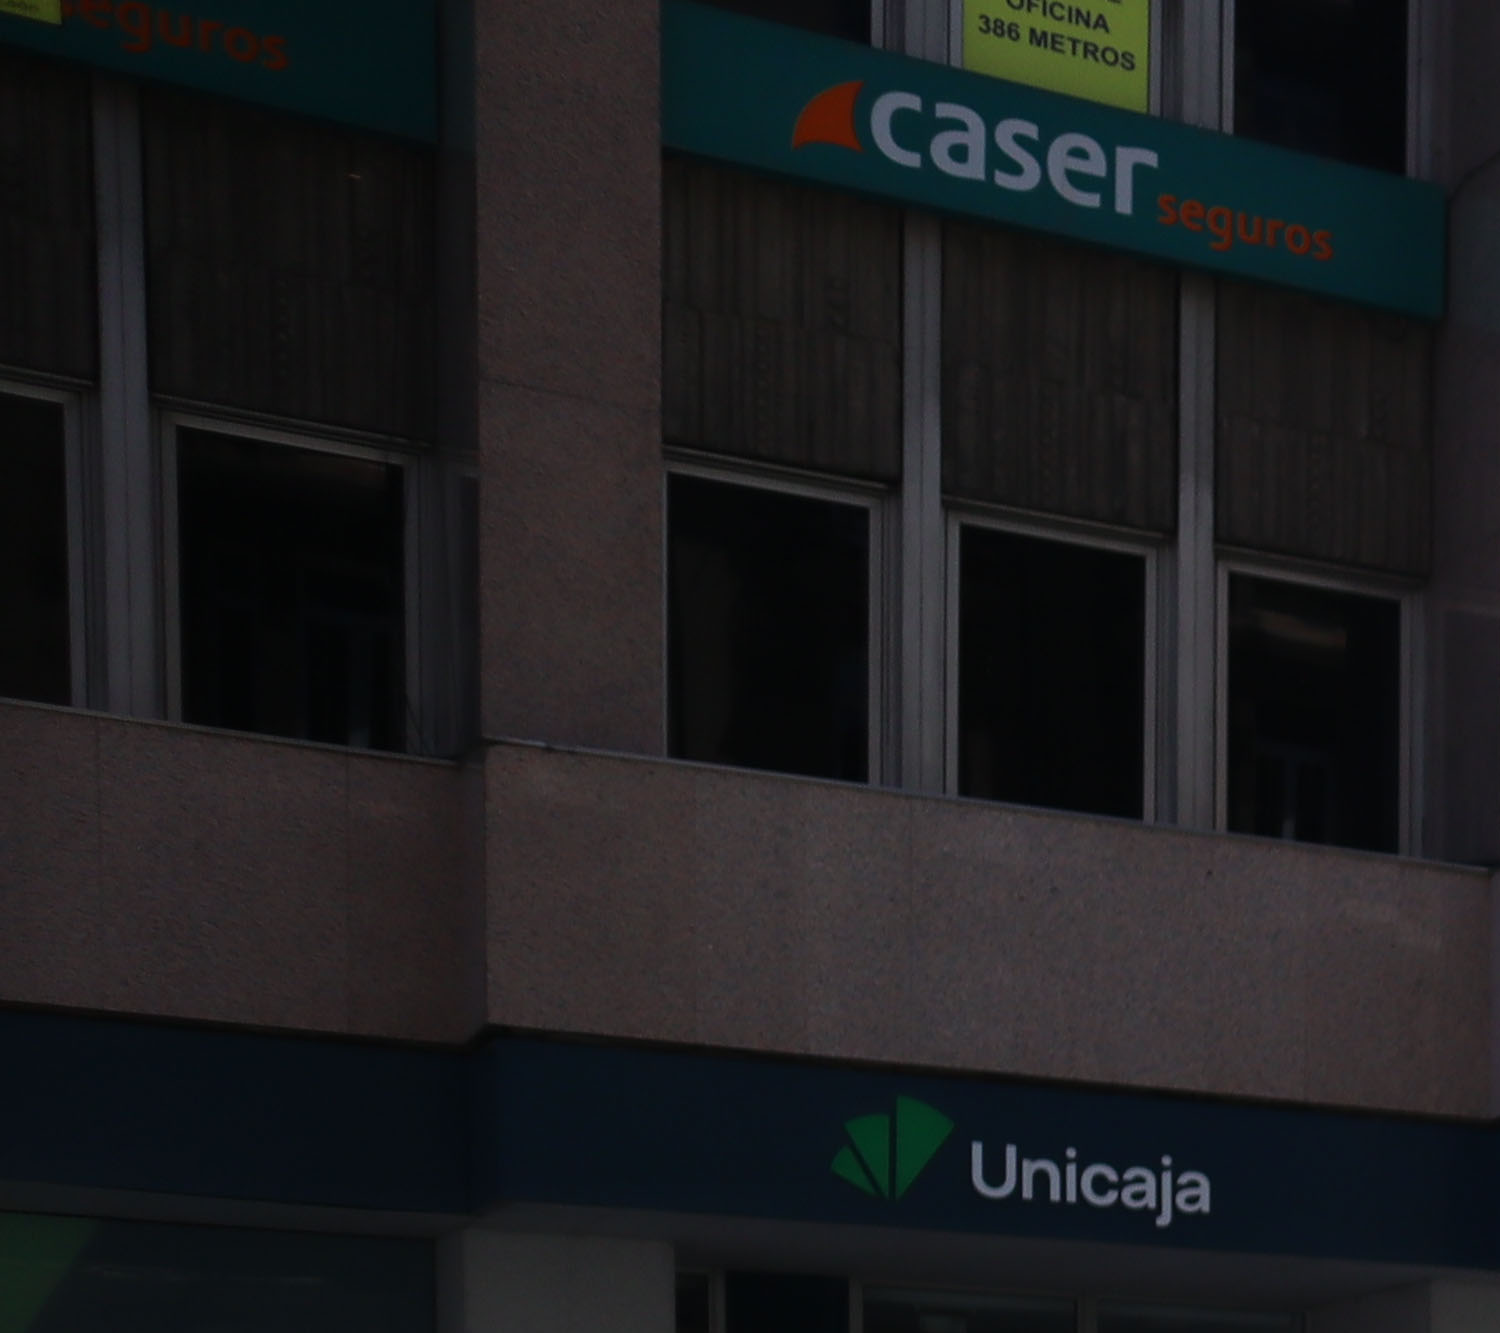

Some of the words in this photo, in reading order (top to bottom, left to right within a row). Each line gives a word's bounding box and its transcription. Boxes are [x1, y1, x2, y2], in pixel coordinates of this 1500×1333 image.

[978, 14, 1021, 43] 386
[1029, 25, 1136, 71] METROS
[870, 90, 1160, 215] caser
[1157, 193, 1335, 261] seguros
[970, 1141, 1211, 1228] Unicaja
